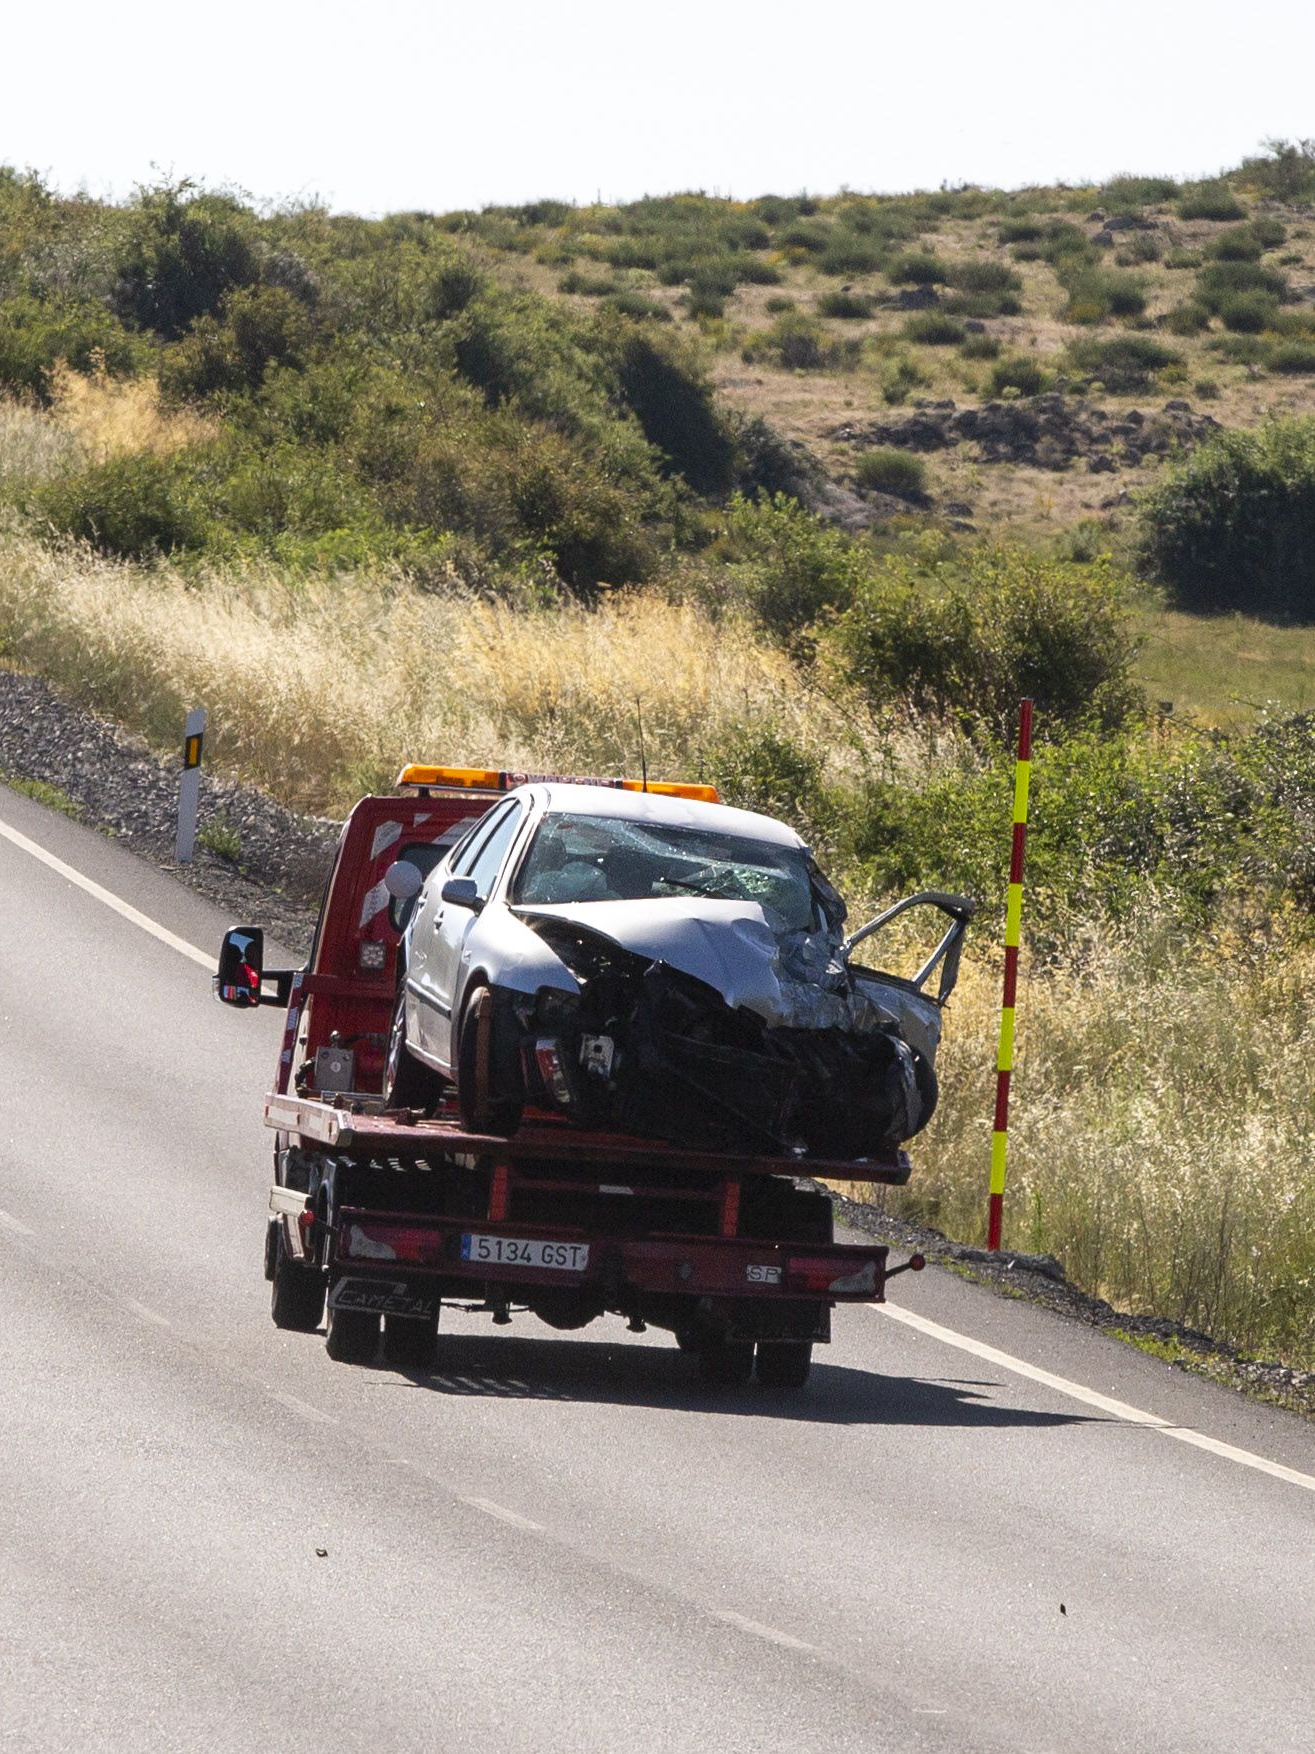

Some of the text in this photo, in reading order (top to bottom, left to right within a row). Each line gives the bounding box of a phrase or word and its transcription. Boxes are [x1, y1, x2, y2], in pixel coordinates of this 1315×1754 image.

[477, 1238, 582, 1268] 5134 GST
[749, 1265, 778, 1281] SP
